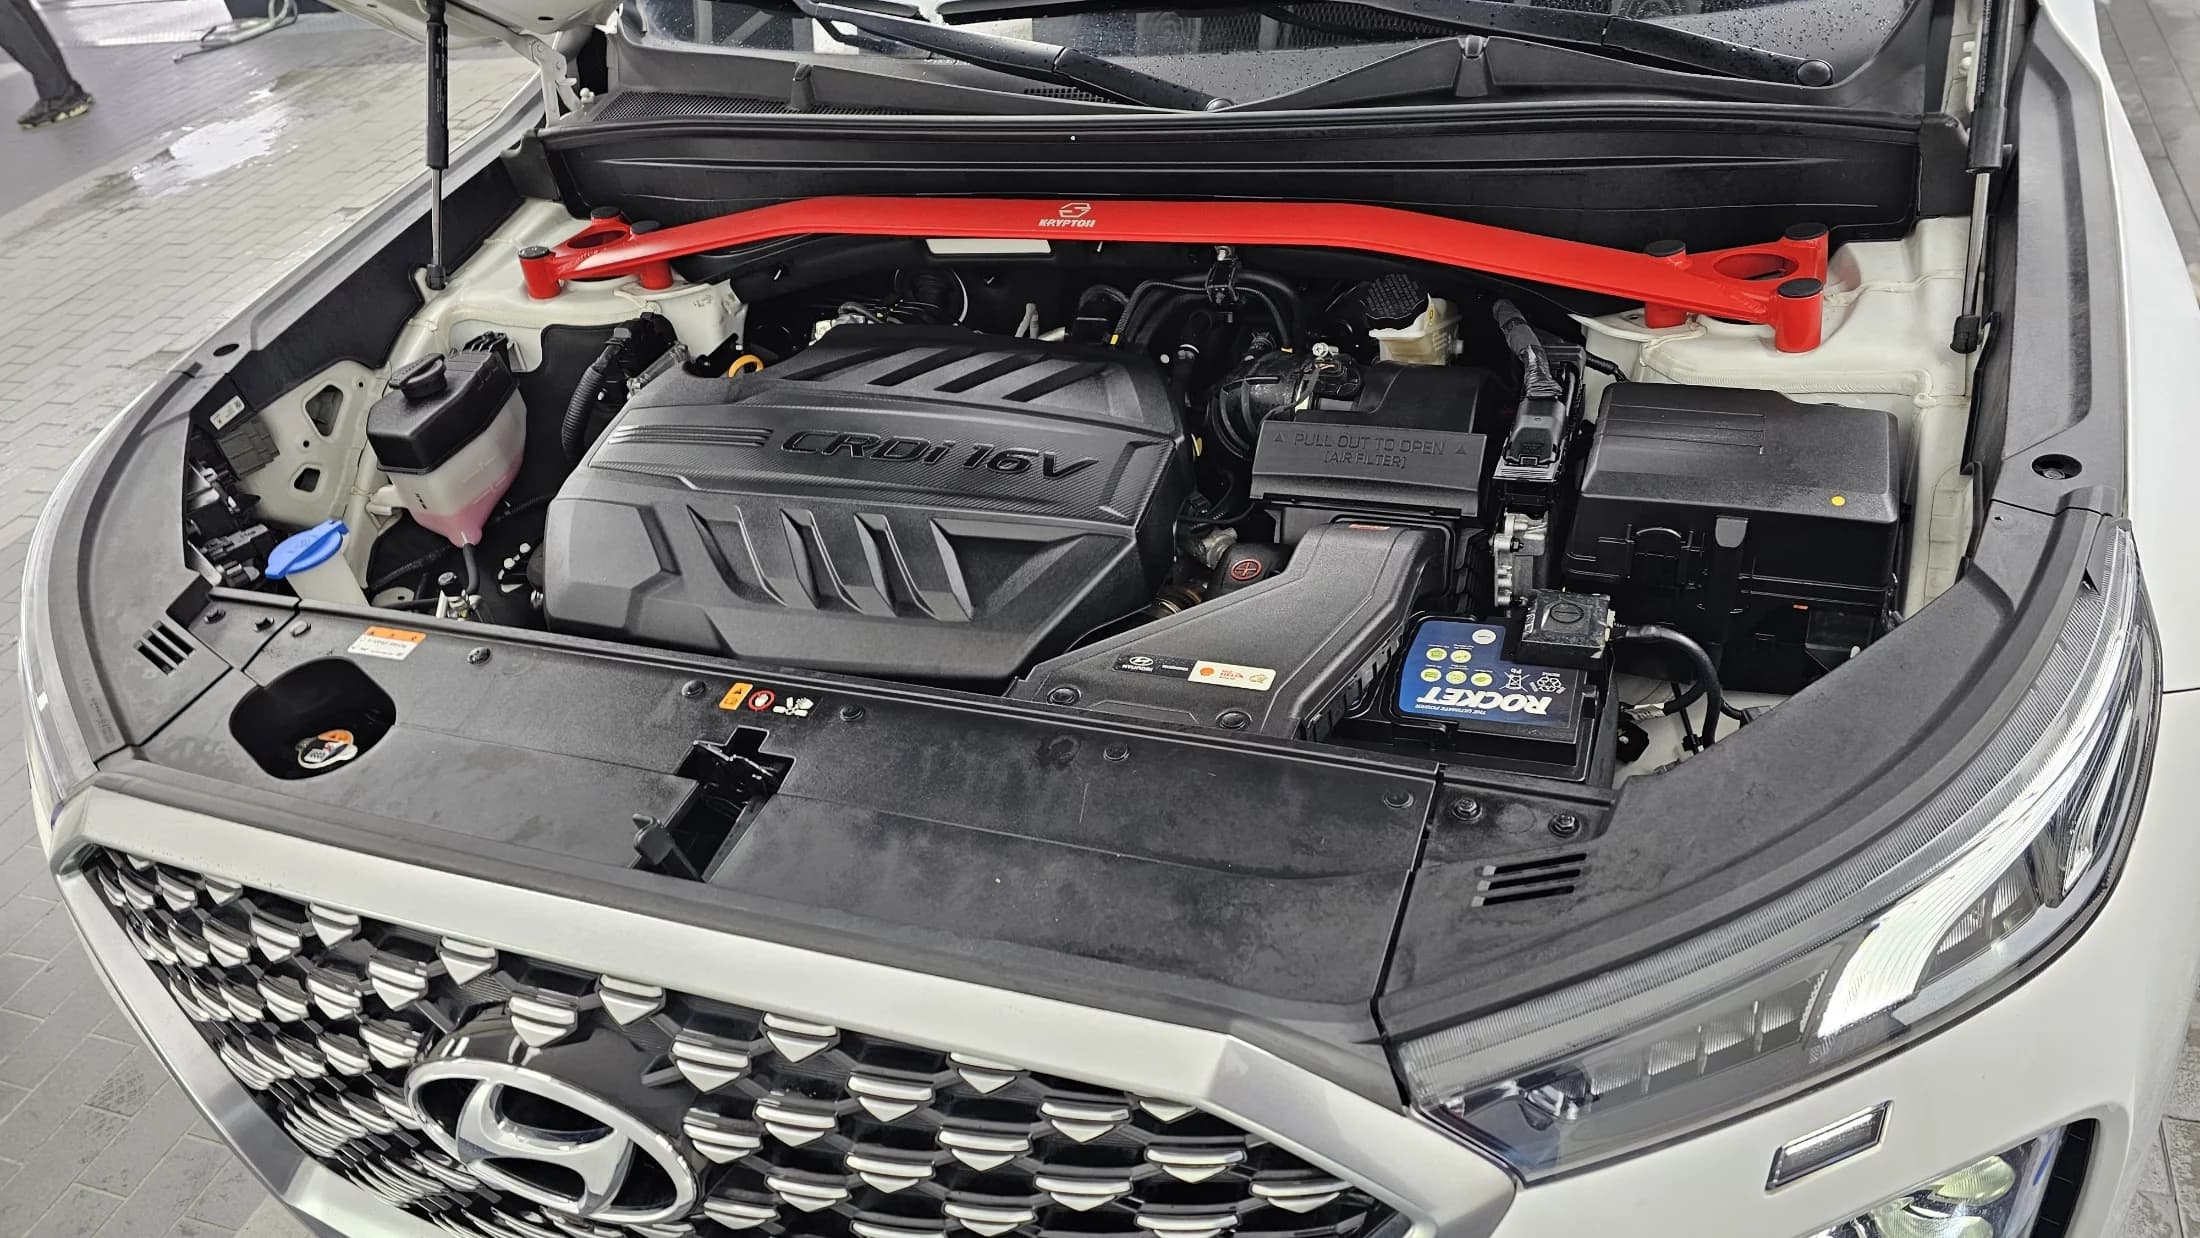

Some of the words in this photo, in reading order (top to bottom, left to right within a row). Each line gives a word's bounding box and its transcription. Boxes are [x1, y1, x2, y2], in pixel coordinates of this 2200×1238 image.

[1038, 218, 1096, 228] KRYPTON
[780, 429, 957, 466] CRDi
[961, 442, 1100, 480] 16V
[1293, 432, 1333, 448] PULL
[1337, 434, 1371, 449] OUT
[1374, 437, 1395, 452] TO
[1399, 439, 1447, 456] OPEN
[1416, 686, 1553, 715] ROCKET
